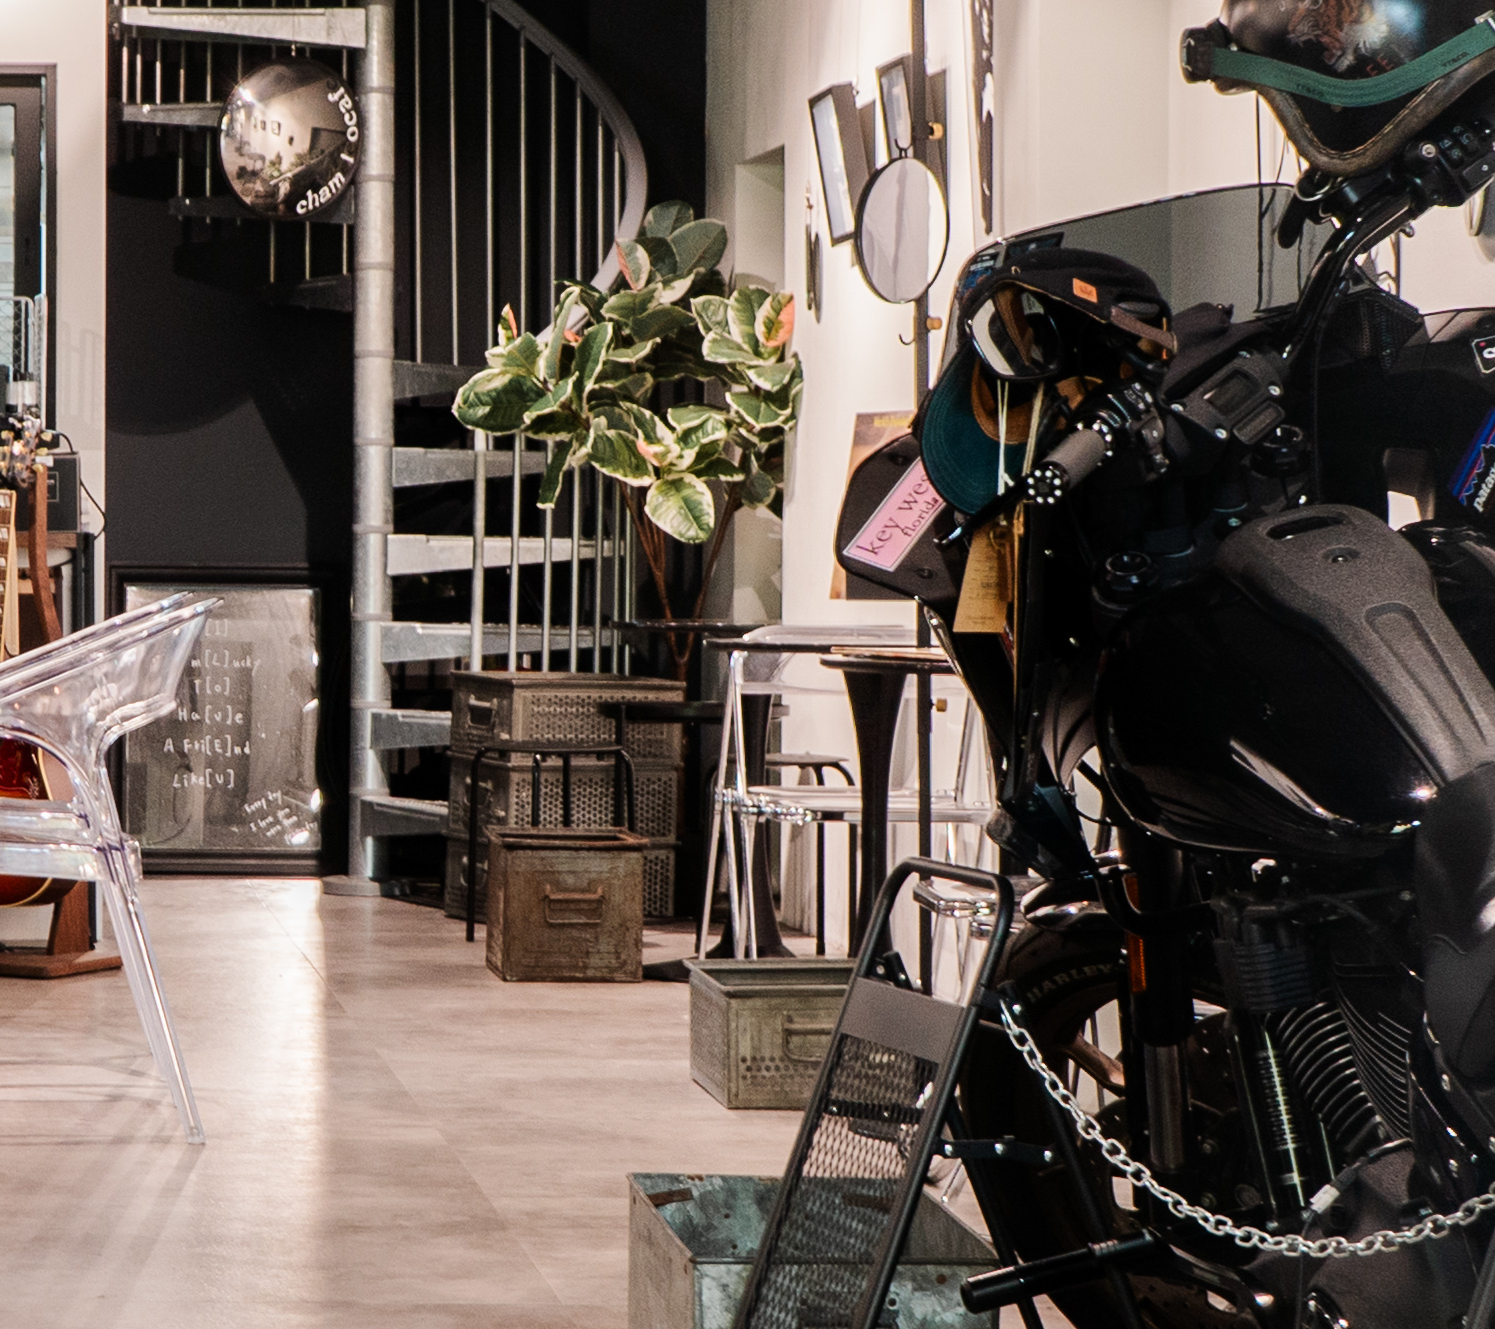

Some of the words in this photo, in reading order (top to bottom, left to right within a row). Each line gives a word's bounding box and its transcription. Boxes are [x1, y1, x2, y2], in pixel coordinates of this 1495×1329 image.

[855, 516, 902, 557] key
[901, 496, 940, 538] florida
[163, 737, 175, 754] A
[1026, 963, 1113, 1005] HARLEY
